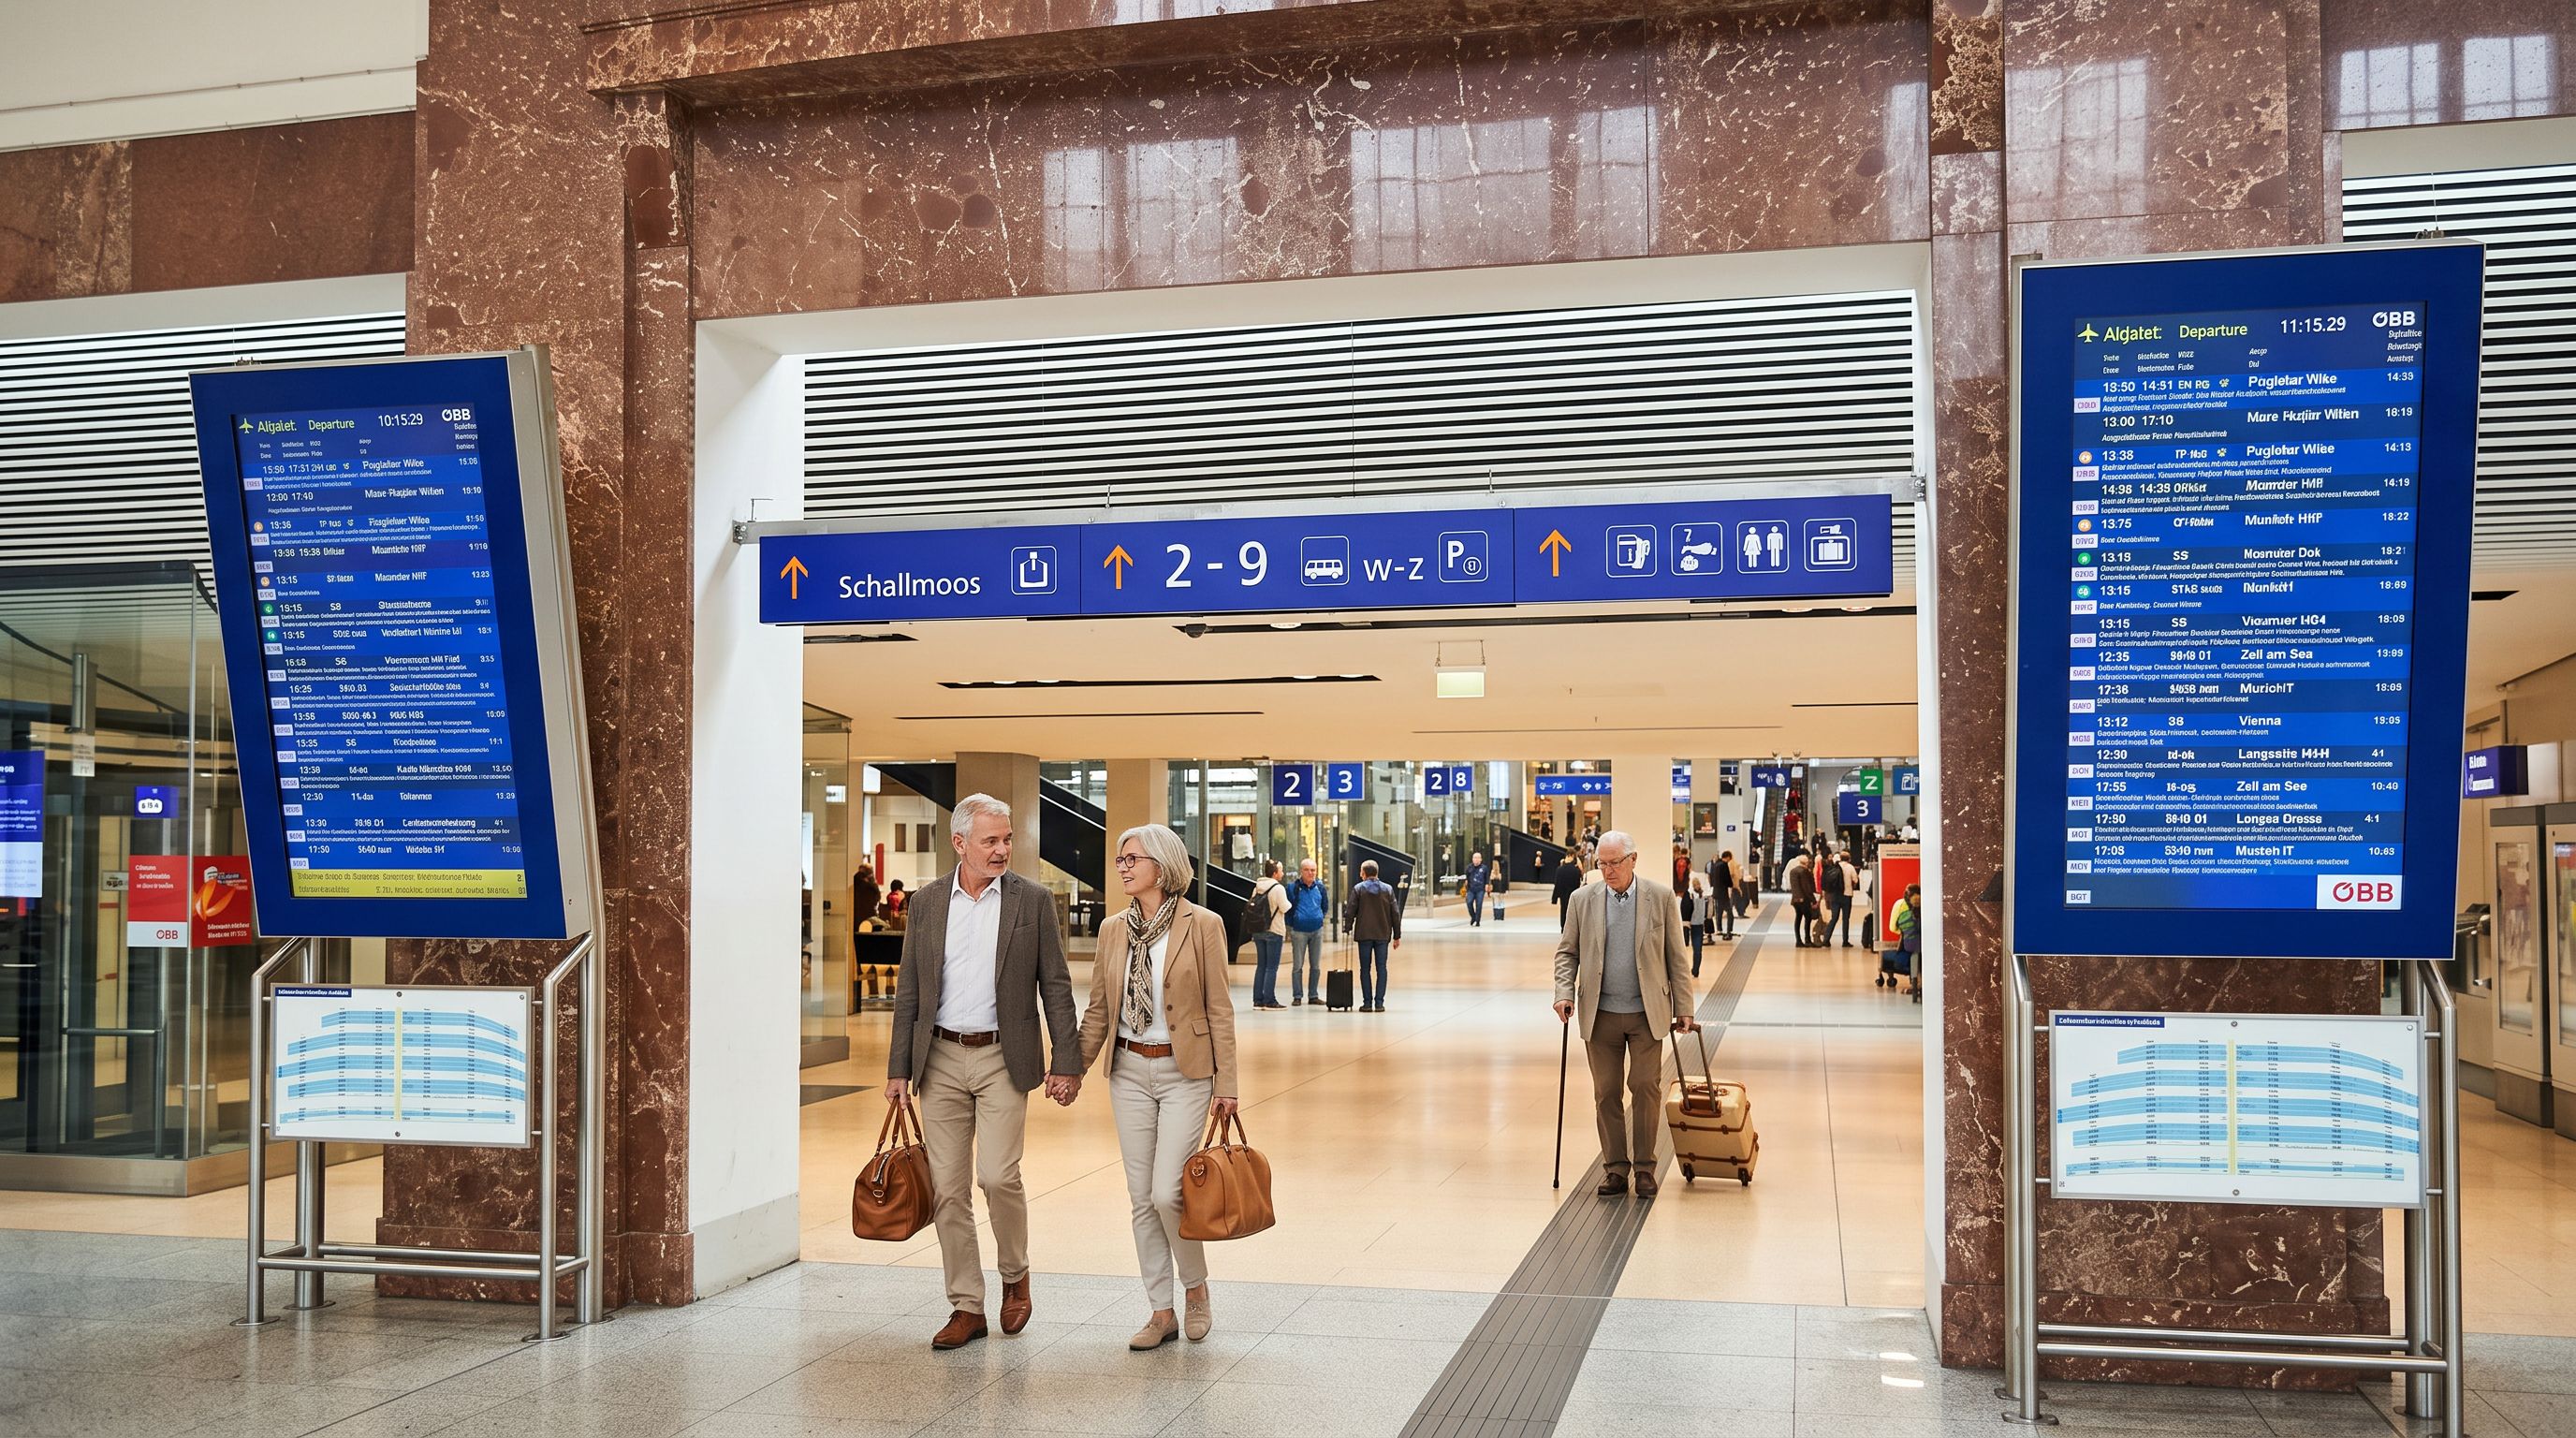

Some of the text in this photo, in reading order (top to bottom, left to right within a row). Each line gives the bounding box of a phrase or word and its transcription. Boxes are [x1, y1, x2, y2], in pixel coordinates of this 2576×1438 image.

[2179, 324, 2248, 341] Departure
[308, 418, 355, 433] Departure
[377, 413, 424, 427] 10:15:29
[2102, 414, 2174, 428] 13:00 17:10
[2101, 449, 2134, 462] 13:38
[2382, 511, 2409, 521] 18:22
[2100, 518, 2132, 530] 13:75
[1447, 540, 1465, 568] P
[2298, 547, 2321, 558] Dok
[1166, 544, 1191, 587] 2
[1239, 541, 1266, 585] 9
[275, 575, 299, 585] 13:15
[840, 573, 980, 598] Schallmoos
[2100, 584, 2131, 596] 13:15
[2099, 618, 2130, 629] 13:15
[2098, 651, 2130, 663] 12:35
[2198, 650, 2212, 661] 01
[2240, 648, 2313, 660] Zell am Sea
[289, 684, 313, 694] 16:25
[2097, 716, 2129, 727] 13:12
[2238, 715, 2282, 726] Vienna
[2097, 749, 2128, 760] 12:30
[2371, 748, 2384, 757] 41
[1284, 772, 1299, 797] 2
[1339, 770, 1352, 792] 3
[1431, 773, 1442, 789] 2
[1456, 772, 1466, 786] 8
[1865, 776, 1878, 789] Z
[2095, 781, 2127, 792] 17:55
[2236, 780, 2307, 792] Zell am See
[1857, 800, 1868, 816] 3
[2193, 813, 2207, 825] 01
[2282, 844, 2295, 857] IT
[2332, 882, 2393, 902] ÖBB
